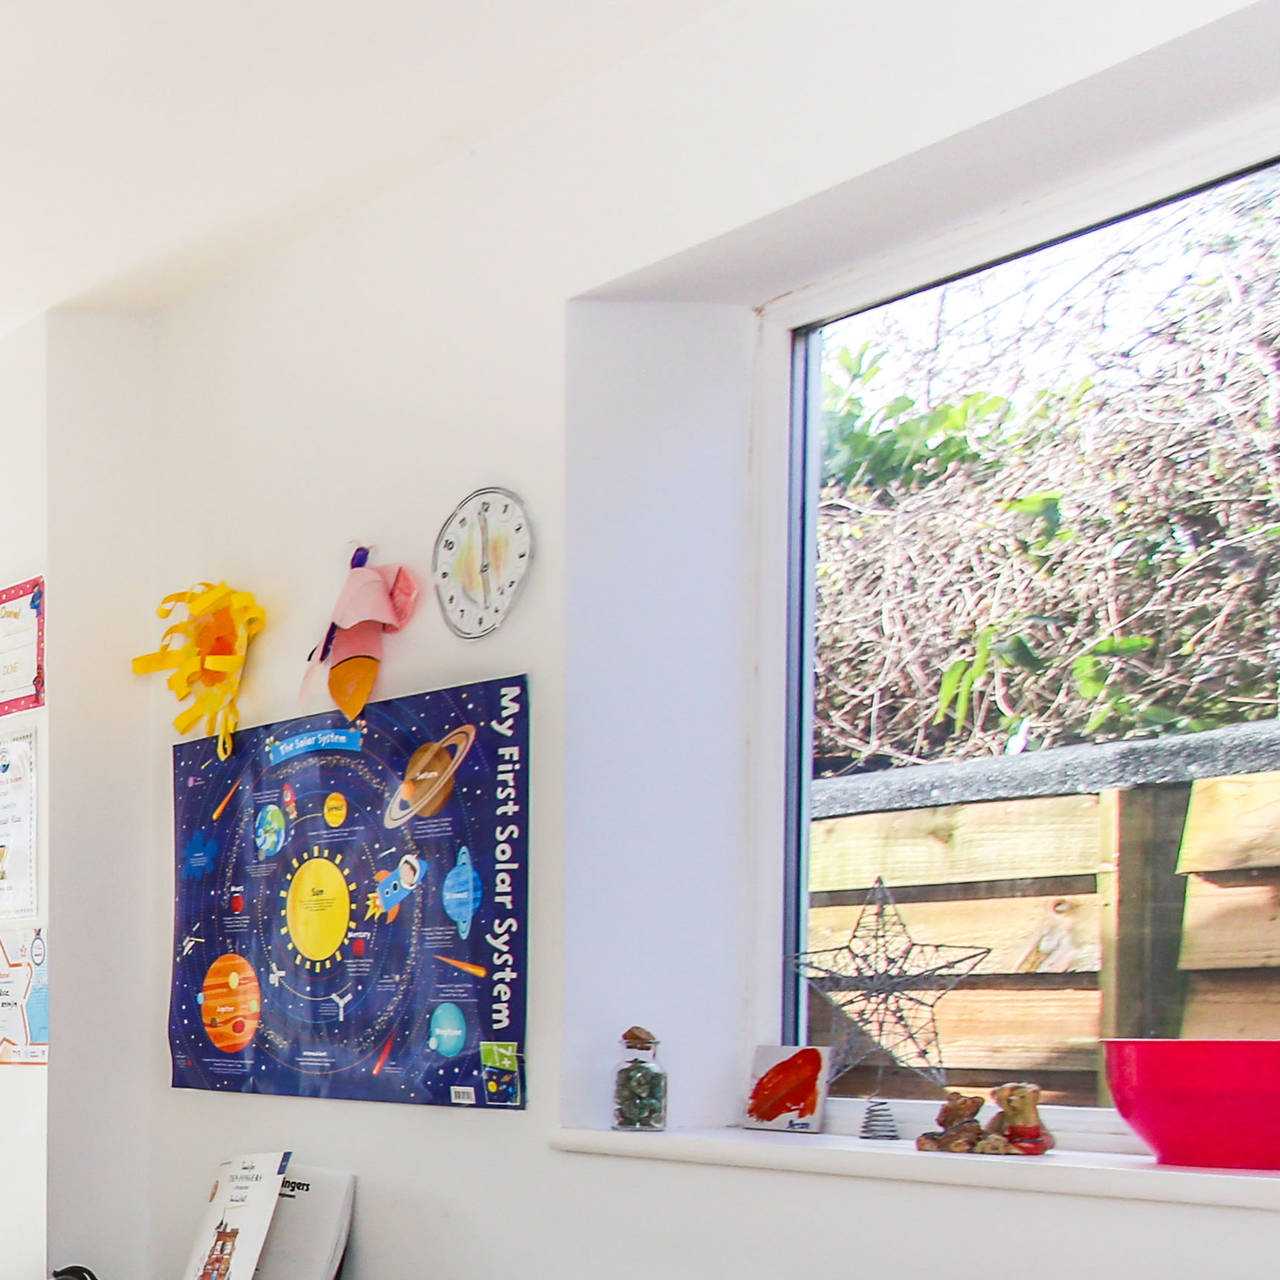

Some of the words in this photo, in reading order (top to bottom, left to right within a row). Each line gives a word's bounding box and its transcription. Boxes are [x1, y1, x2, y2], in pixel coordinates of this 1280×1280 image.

[295, 736, 316, 749] Solar
[318, 733, 347, 747] System
[490, 686, 522, 737] My
[496, 746, 521, 816] First
[494, 824, 520, 909] Solar
[485, 917, 518, 1029] System
[281, 1177, 310, 1192] ingers
